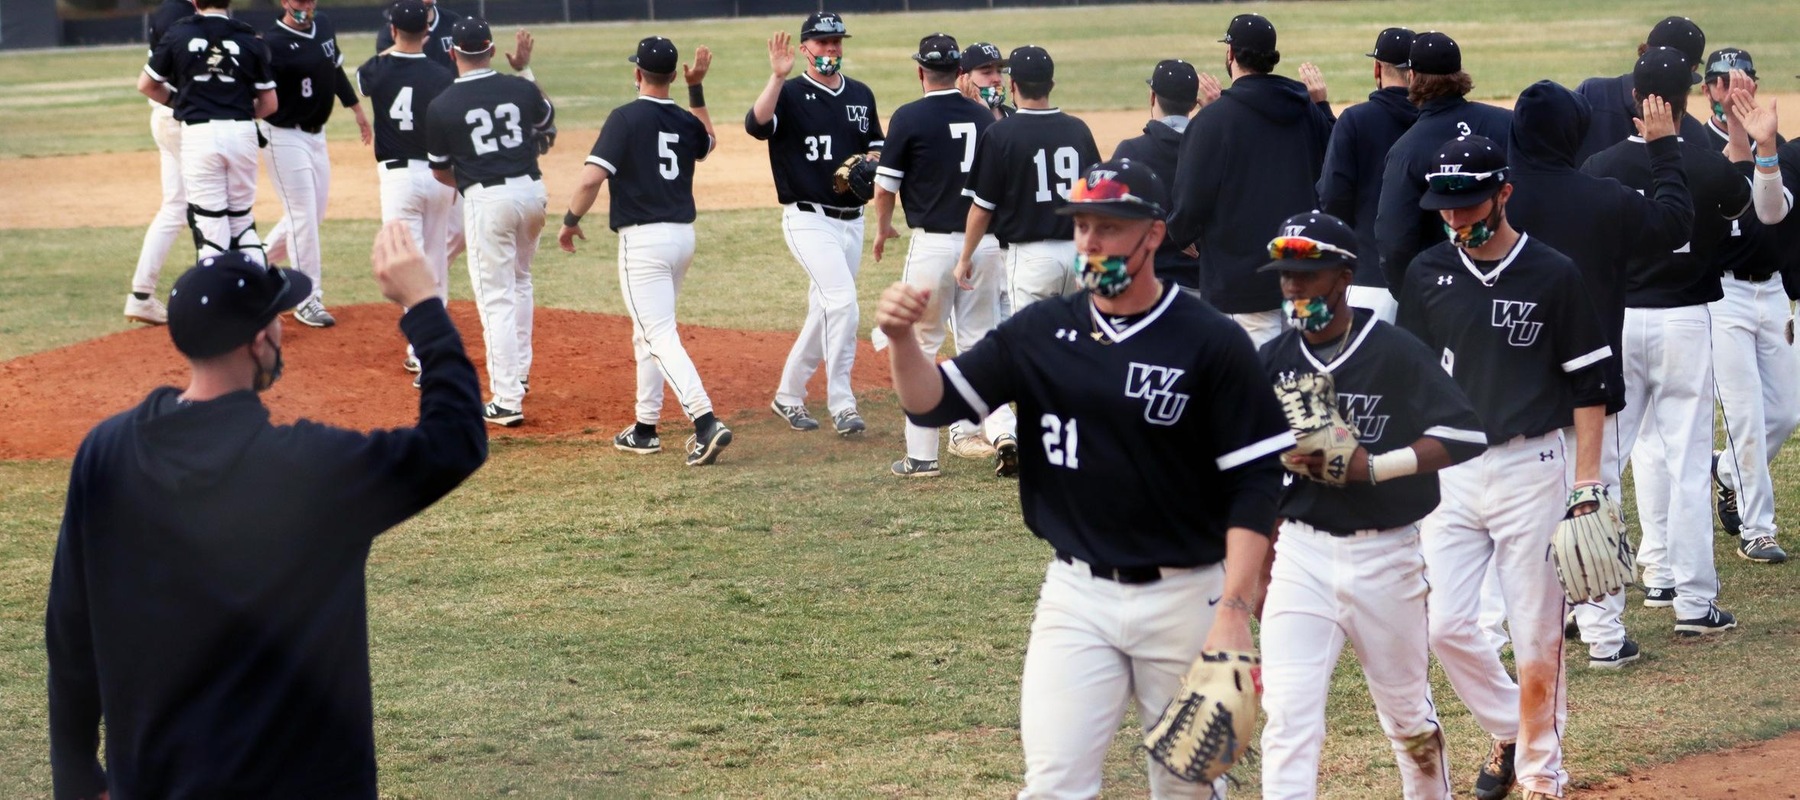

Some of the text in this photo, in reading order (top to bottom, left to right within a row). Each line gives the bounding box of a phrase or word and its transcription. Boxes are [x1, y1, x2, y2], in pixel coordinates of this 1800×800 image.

[302, 78, 312, 97] 8
[389, 87, 413, 130] 4
[465, 103, 523, 156] 23
[846, 105, 869, 133] WU
[1457, 122, 1471, 136] 3
[658, 131, 679, 180] 5
[805, 135, 833, 162] 37
[949, 122, 977, 172] 7
[1034, 146, 1079, 203] 19
[1492, 299, 1543, 346] WU
[1125, 362, 1189, 425] WU
[1041, 413, 1079, 469] 21
[1336, 393, 1390, 443] WU
[1328, 455, 1345, 479] 44
